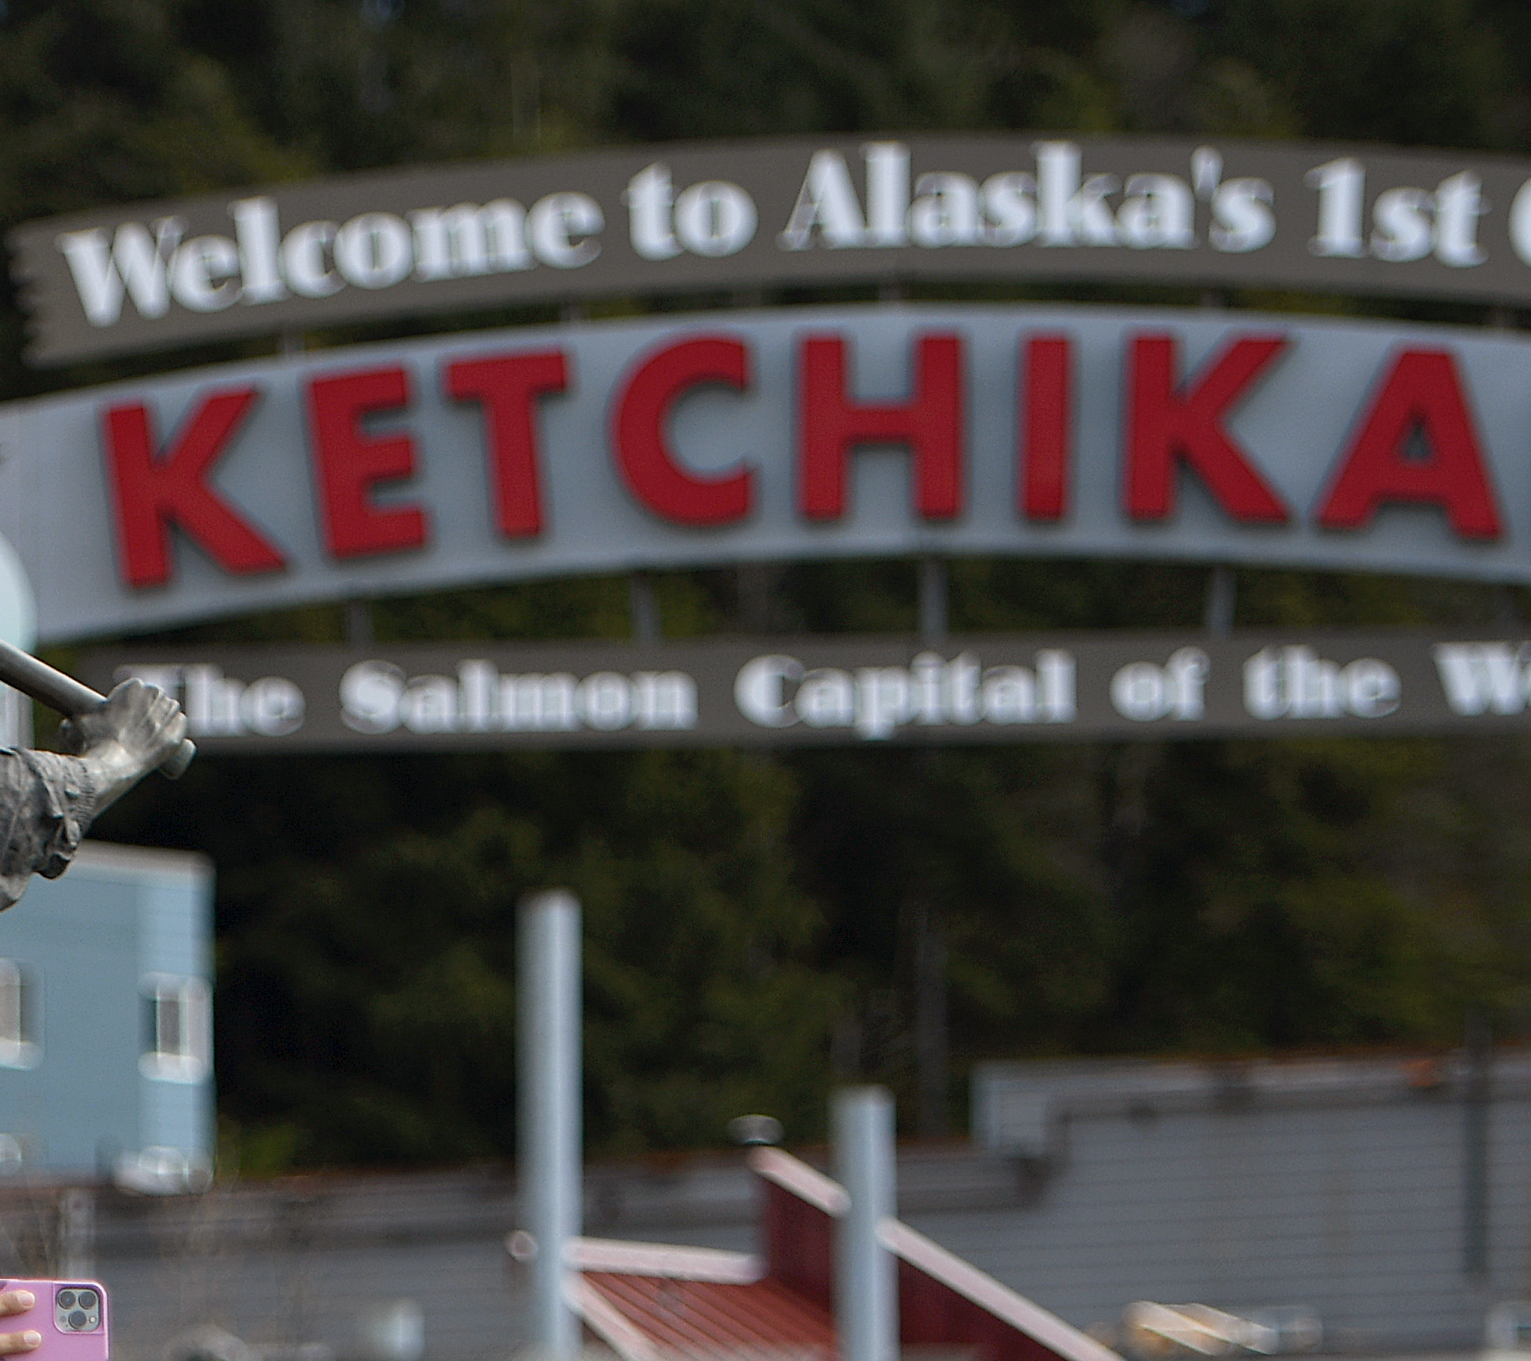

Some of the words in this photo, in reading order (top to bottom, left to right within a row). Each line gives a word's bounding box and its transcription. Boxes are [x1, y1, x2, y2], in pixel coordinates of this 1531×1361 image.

[58, 196, 607, 328] Welcome
[624, 162, 759, 262] to
[778, 139, 1277, 254] Alaska's
[1305, 157, 1490, 268] 1st
[339, 658, 699, 736] Salmon
[735, 648, 1077, 740] Capital
[1109, 646, 1211, 722] of
[1241, 643, 1402, 722] the
